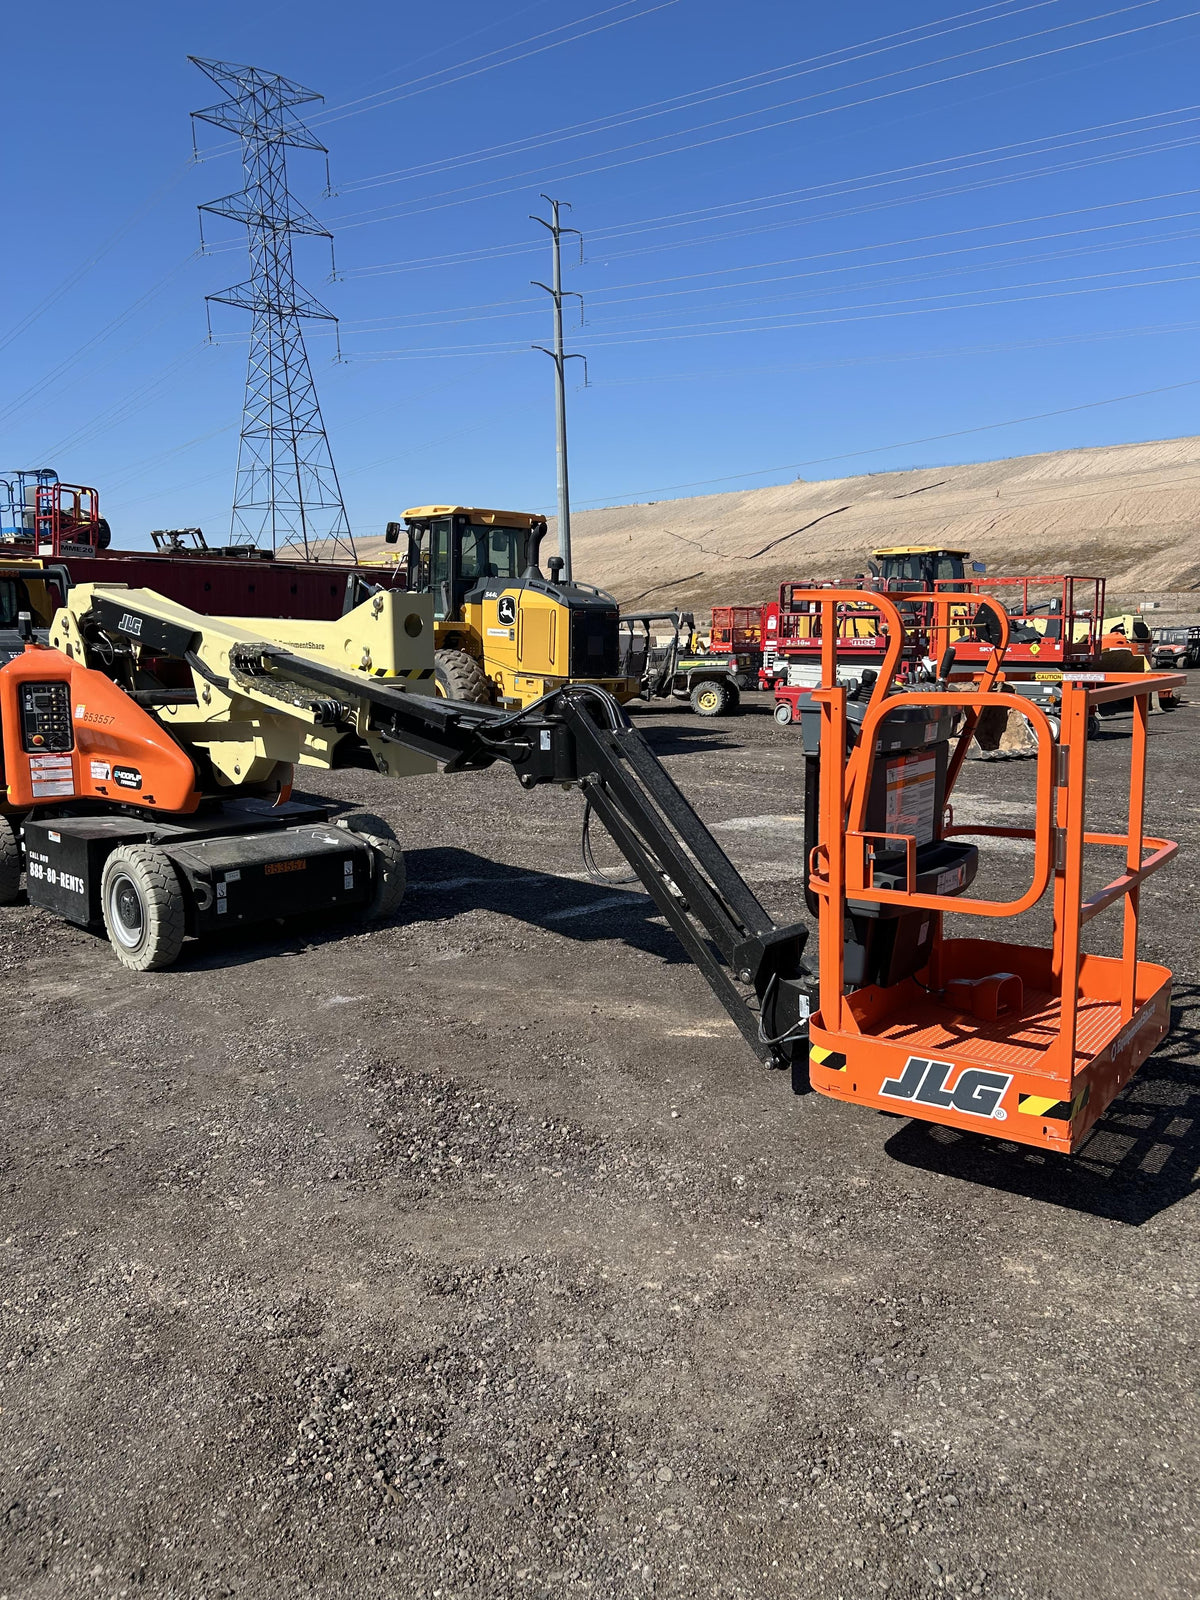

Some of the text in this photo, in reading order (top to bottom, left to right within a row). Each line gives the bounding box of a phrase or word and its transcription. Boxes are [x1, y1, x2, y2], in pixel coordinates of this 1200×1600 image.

[118, 613, 142, 636] JLG
[83, 712, 116, 725] 653557
[30, 851, 39, 860] CALL
[265, 860, 306, 875] 653557
[30, 862, 84, 894] 888-80-RENTS
[877, 1055, 1015, 1120] JLG
